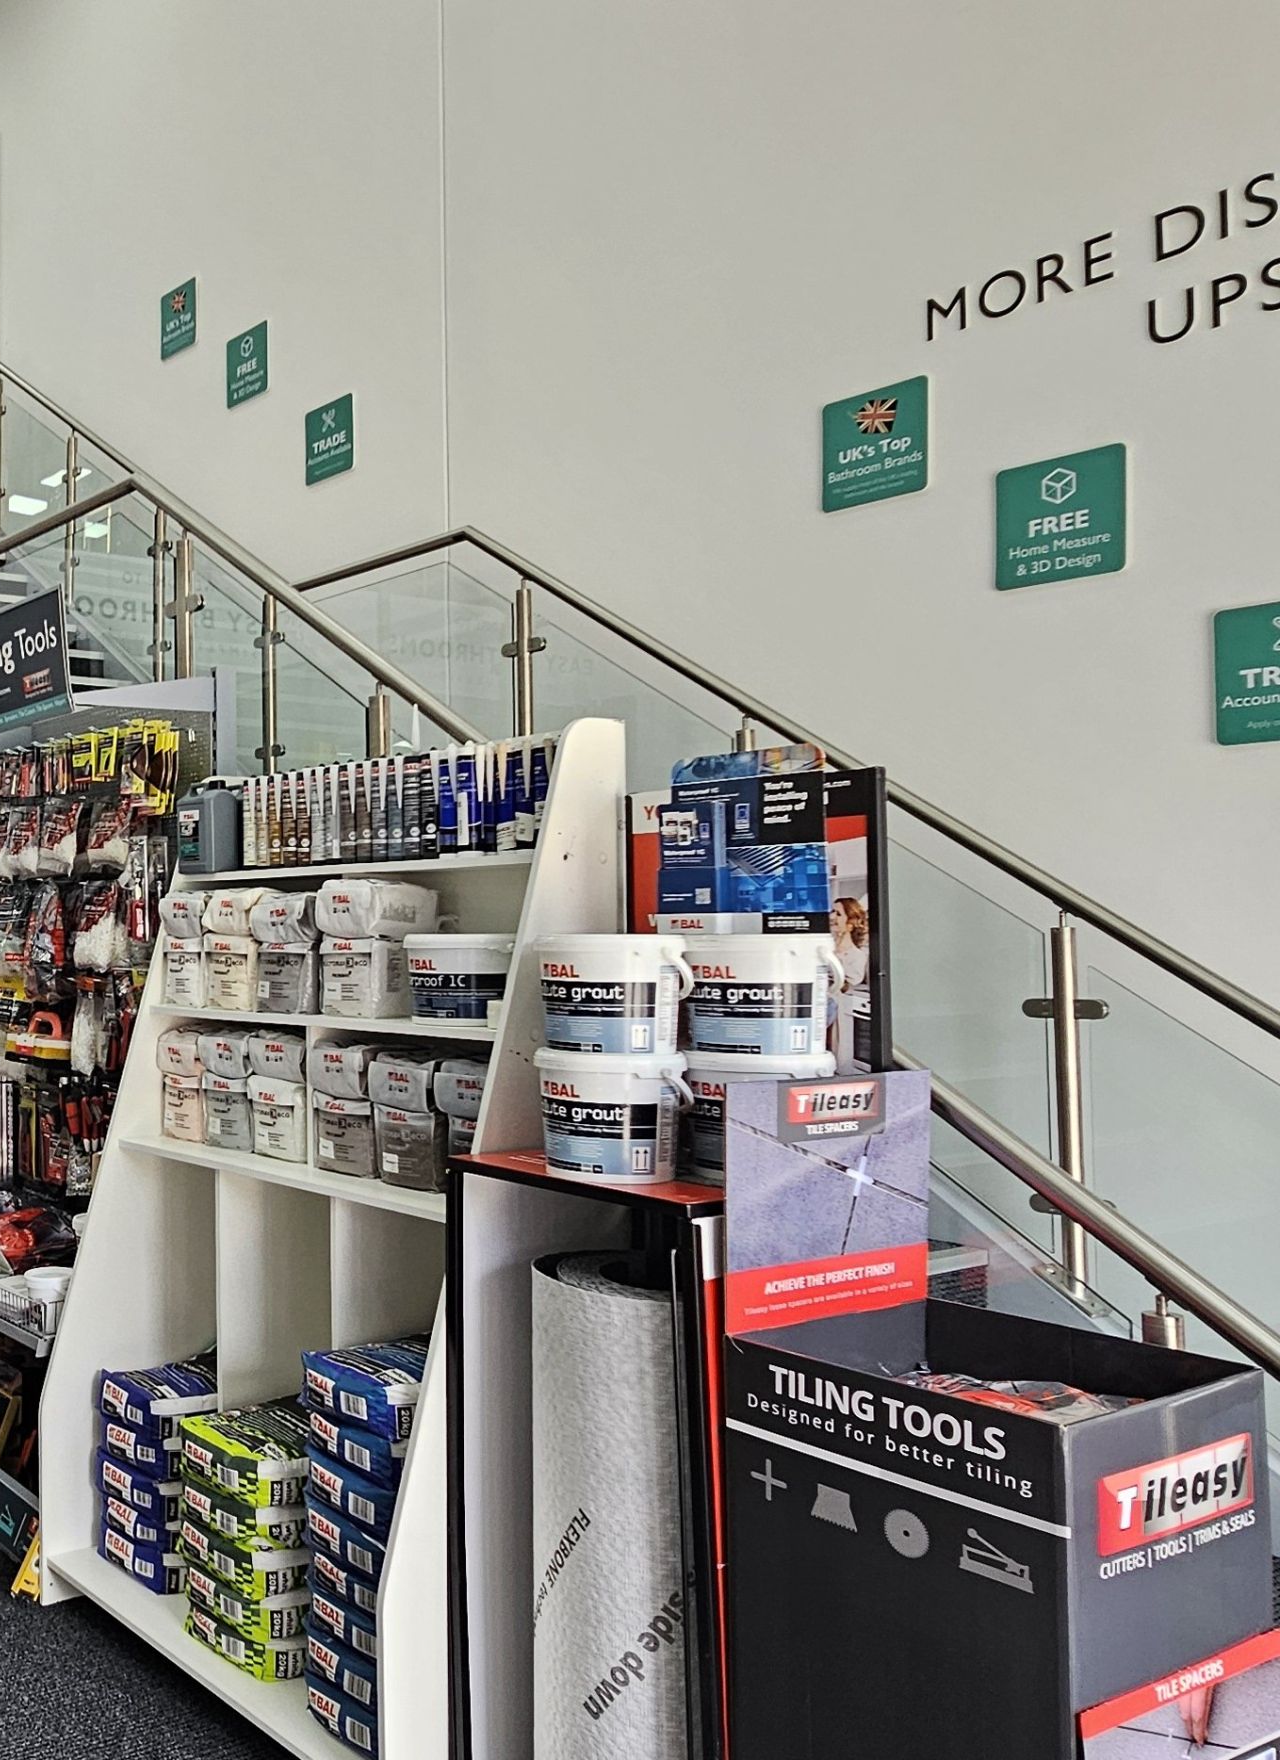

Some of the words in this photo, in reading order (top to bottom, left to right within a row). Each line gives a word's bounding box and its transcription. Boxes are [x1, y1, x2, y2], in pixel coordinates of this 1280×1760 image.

[926, 231, 1115, 342] MORE
[1154, 173, 1279, 262] DIS
[236, 357, 257, 378] FREE
[312, 430, 346, 455] TRADE
[838, 444, 876, 464] UK's
[878, 436, 912, 453] Top
[828, 463, 881, 484] Bathroom
[884, 450, 924, 469] Brands
[1028, 509, 1091, 538] FREE
[1008, 544, 1050, 560] Home
[1053, 532, 1111, 552] Measure
[1016, 564, 1027, 576] &
[1031, 559, 1051, 574] 3D
[1055, 553, 1102, 570] Design
[14, 619, 57, 660] Tools
[681, 919, 704, 929] BAL
[449, 975, 466, 987] 1C
[551, 964, 580, 978] BAL
[702, 966, 736, 979] BAL
[571, 985, 625, 1002] grout
[727, 985, 784, 1003] grout
[551, 1083, 580, 1098] BAL
[702, 1083, 725, 1097] BA
[797, 1091, 874, 1115] Tileasy
[572, 1107, 624, 1122] grout
[806, 1123, 825, 1135] TILE
[825, 1121, 859, 1134] SPACERS
[764, 1277, 806, 1295] ACHIEVE
[807, 1274, 825, 1287] THE
[826, 1268, 865, 1284] PERFECT
[865, 1262, 895, 1278] FINISH
[400, 1410, 410, 1436] 20kg
[769, 1364, 874, 1422] TILING
[882, 1396, 1007, 1460] TOOLS
[747, 1393, 835, 1434] Designed
[845, 1422, 874, 1445] for
[885, 1435, 955, 1470] better
[966, 1461, 1033, 1498] tiling
[1117, 1454, 1247, 1531] Tileasy
[545, 1507, 592, 1588] FLEXBONE
[1100, 1551, 1145, 1580] CUTTERS
[1154, 1537, 1187, 1560] TOOLS
[1193, 1524, 1221, 1546] TRIMS
[1220, 1521, 1231, 1535] &
[1230, 1510, 1255, 1532] SEALS
[272, 1612, 281, 1638] 20kg
[276, 1654, 286, 1678] 20kg
[583, 1650, 644, 1720] down
[1154, 1678, 1180, 1702] TILE
[1178, 1660, 1224, 1695] SPACERS
